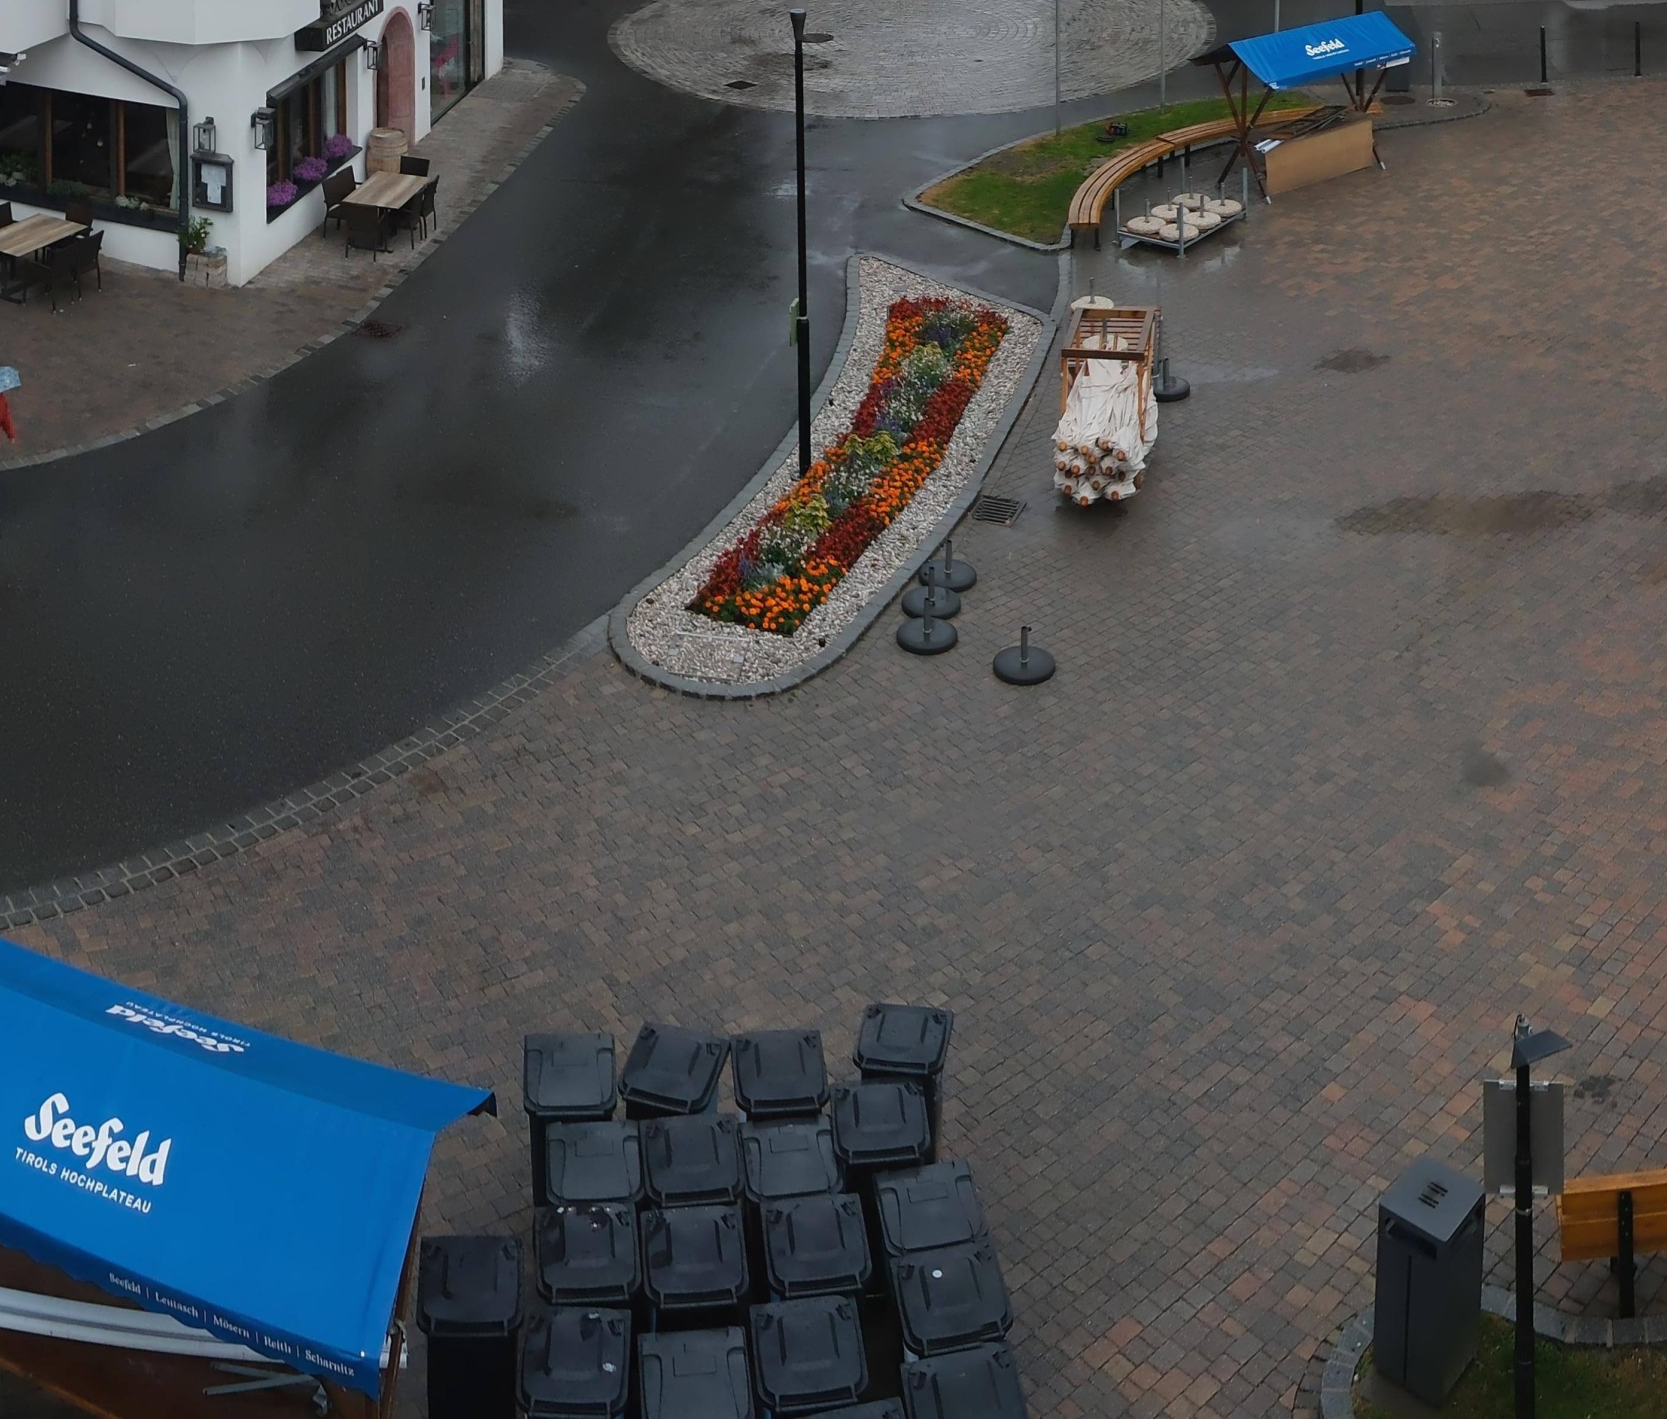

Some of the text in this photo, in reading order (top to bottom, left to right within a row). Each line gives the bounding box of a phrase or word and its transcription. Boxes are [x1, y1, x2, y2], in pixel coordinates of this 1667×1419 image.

[1305, 38, 1345, 57] Seefeld
[105, 1003, 244, 1054] Seefeld
[23, 1091, 172, 1187] Seefeld
[14, 1146, 153, 1215] TIROLS HOCHPLATEAU
[108, 1271, 355, 1377] Seefeld Leutasch Mösern Reith Scharnitz
